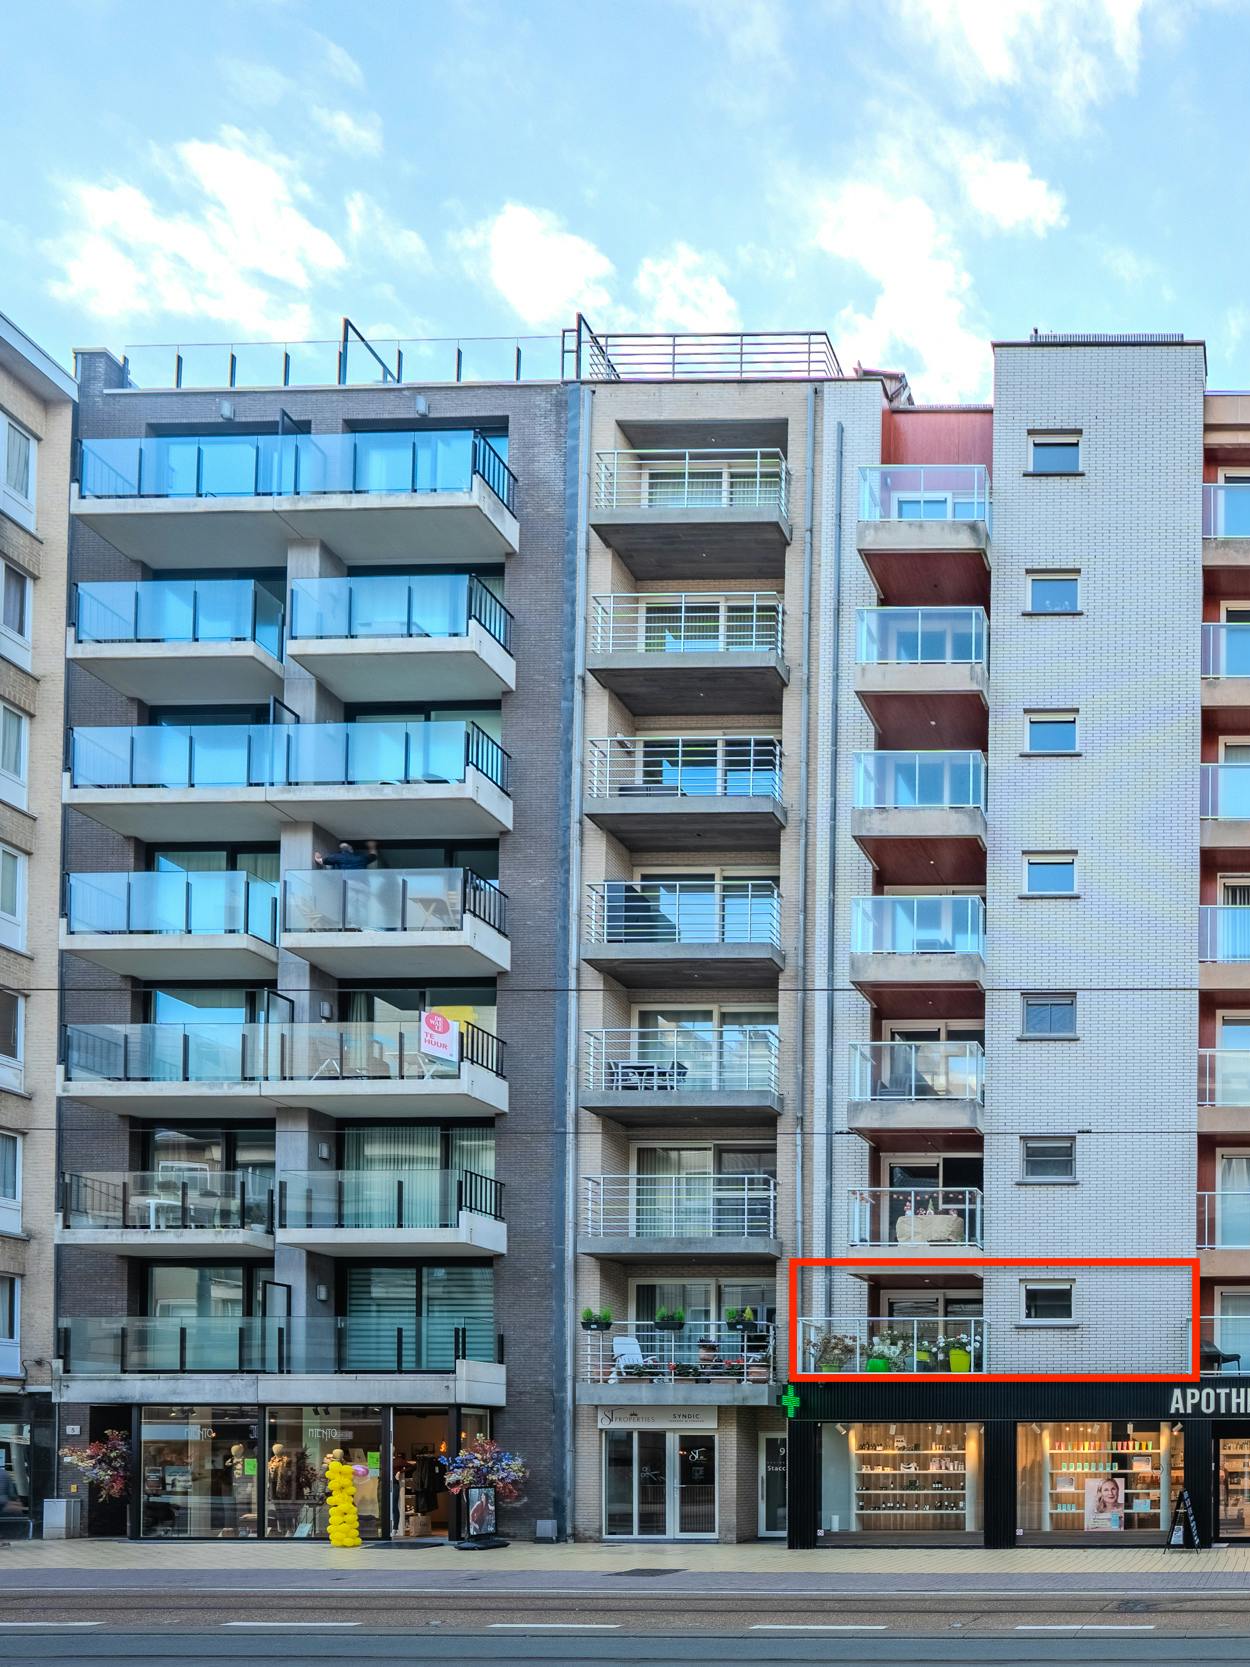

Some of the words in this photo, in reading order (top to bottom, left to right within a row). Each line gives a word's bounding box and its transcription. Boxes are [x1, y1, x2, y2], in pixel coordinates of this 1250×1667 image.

[424, 1031, 434, 1039] TE
[424, 1038, 448, 1051] HUUR
[779, 1447, 786, 1456] 9
